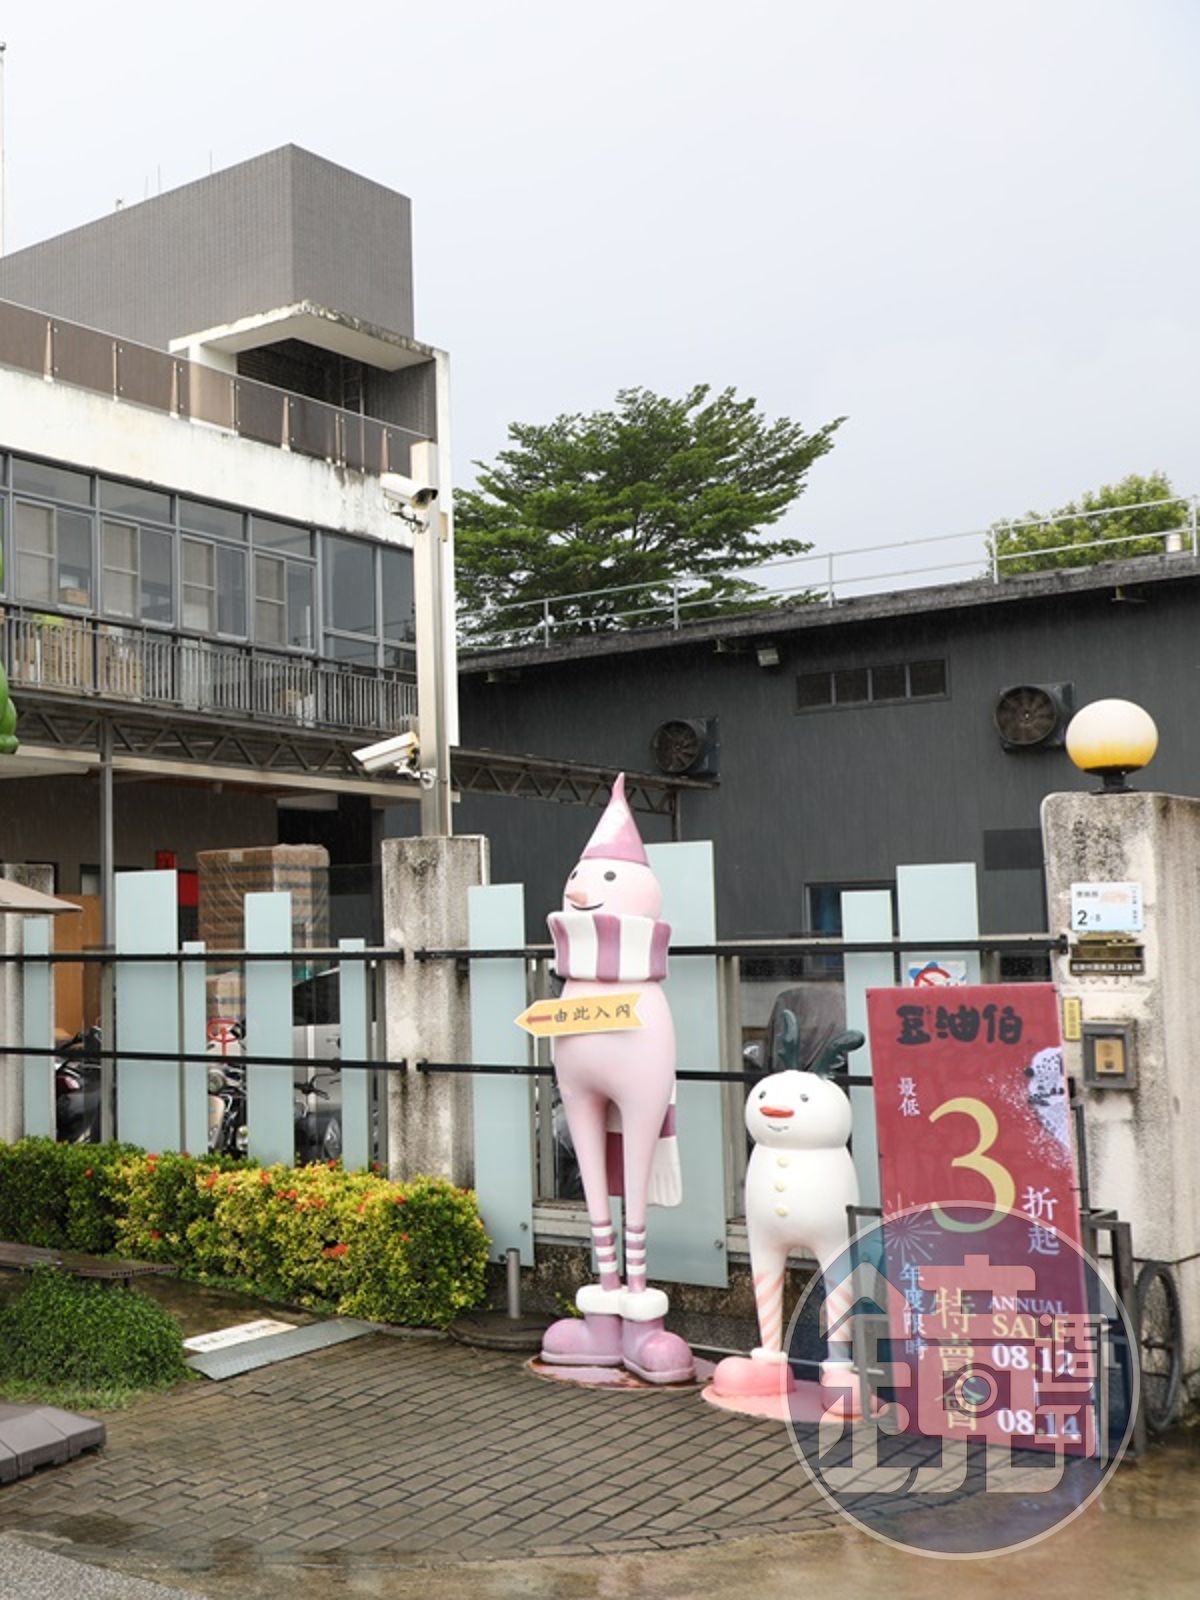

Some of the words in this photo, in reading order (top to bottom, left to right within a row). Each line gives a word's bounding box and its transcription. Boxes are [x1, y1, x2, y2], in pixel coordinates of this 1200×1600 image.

[554, 1003, 631, 1023] 由此入內
[896, 1003, 1023, 1045] 豆油伯
[898, 1077, 920, 1117] 最低
[928, 1096, 1017, 1234] 3
[1021, 1185, 1061, 1256] 折起
[901, 1263, 928, 1362] 年度限時
[988, 1296, 1069, 1317] ANNUAL
[992, 1314, 1070, 1343] SALE
[931, 1286, 986, 1433] 特賣會
[991, 1343, 1075, 1376] 08.12
[997, 1408, 1083, 1441] 08.14
